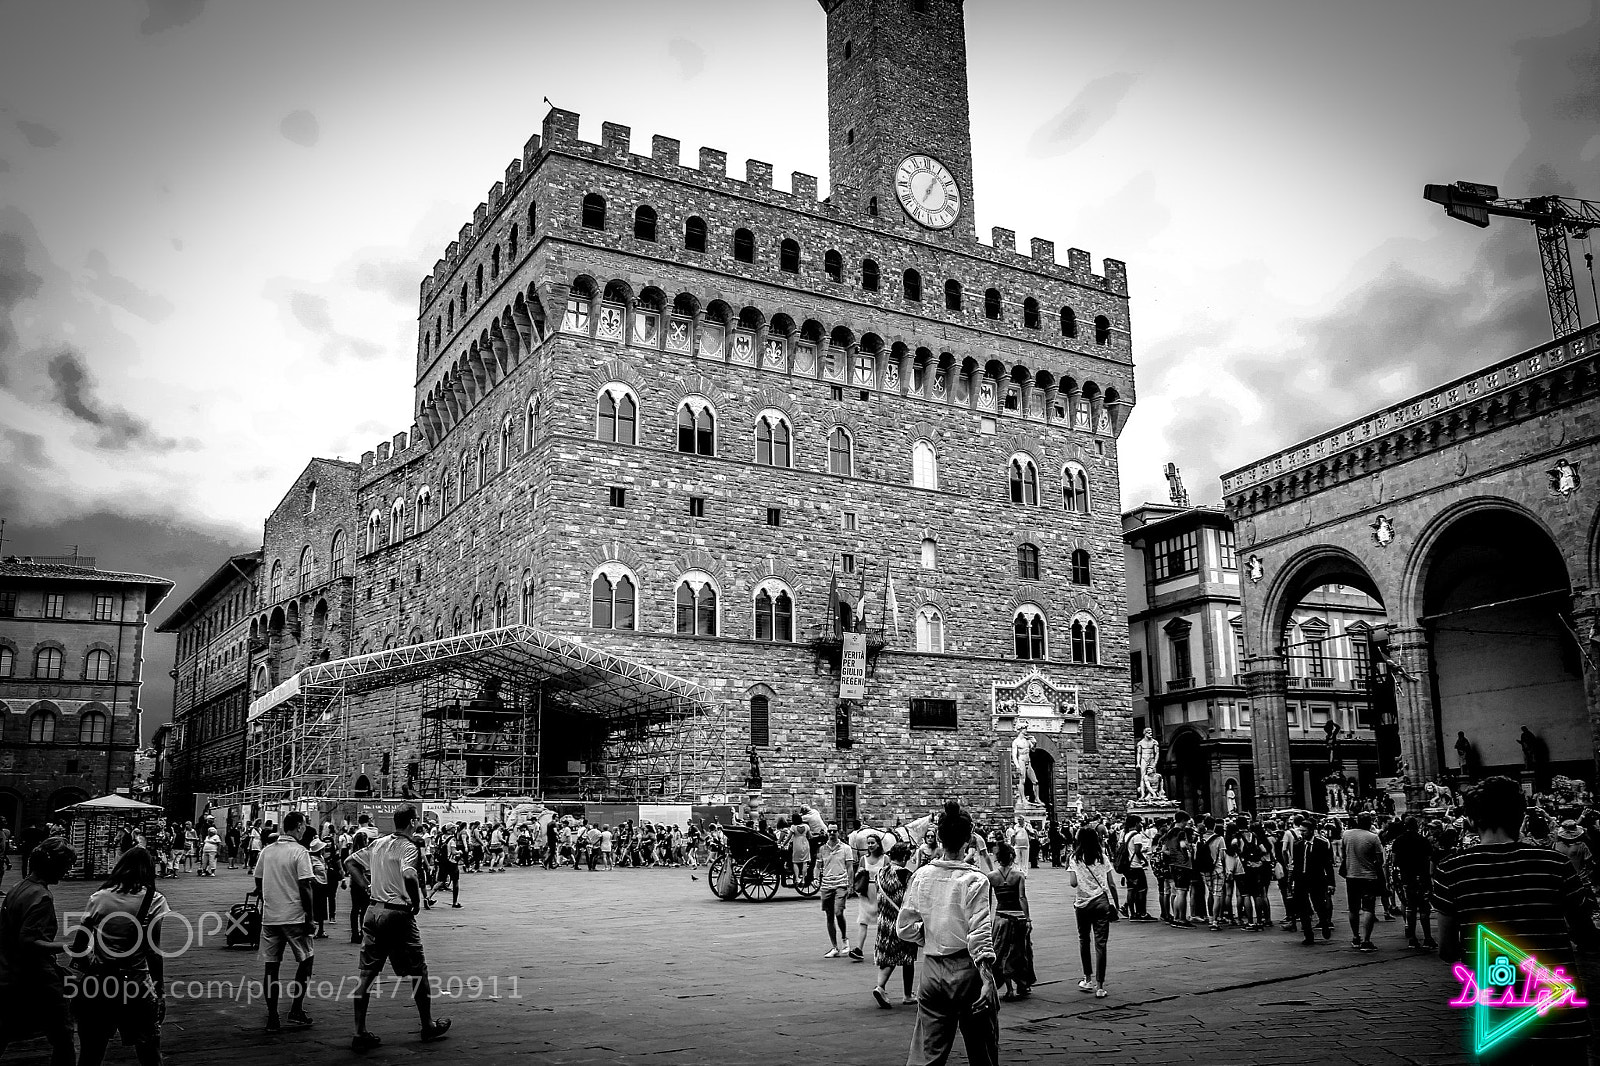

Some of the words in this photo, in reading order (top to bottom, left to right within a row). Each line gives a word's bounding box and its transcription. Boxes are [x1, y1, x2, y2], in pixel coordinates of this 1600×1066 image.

[844, 650, 864, 660] VERITÀ
[843, 659, 855, 667] PER
[842, 668, 863, 676] GIULIO
[842, 677, 864, 686] REGENI
